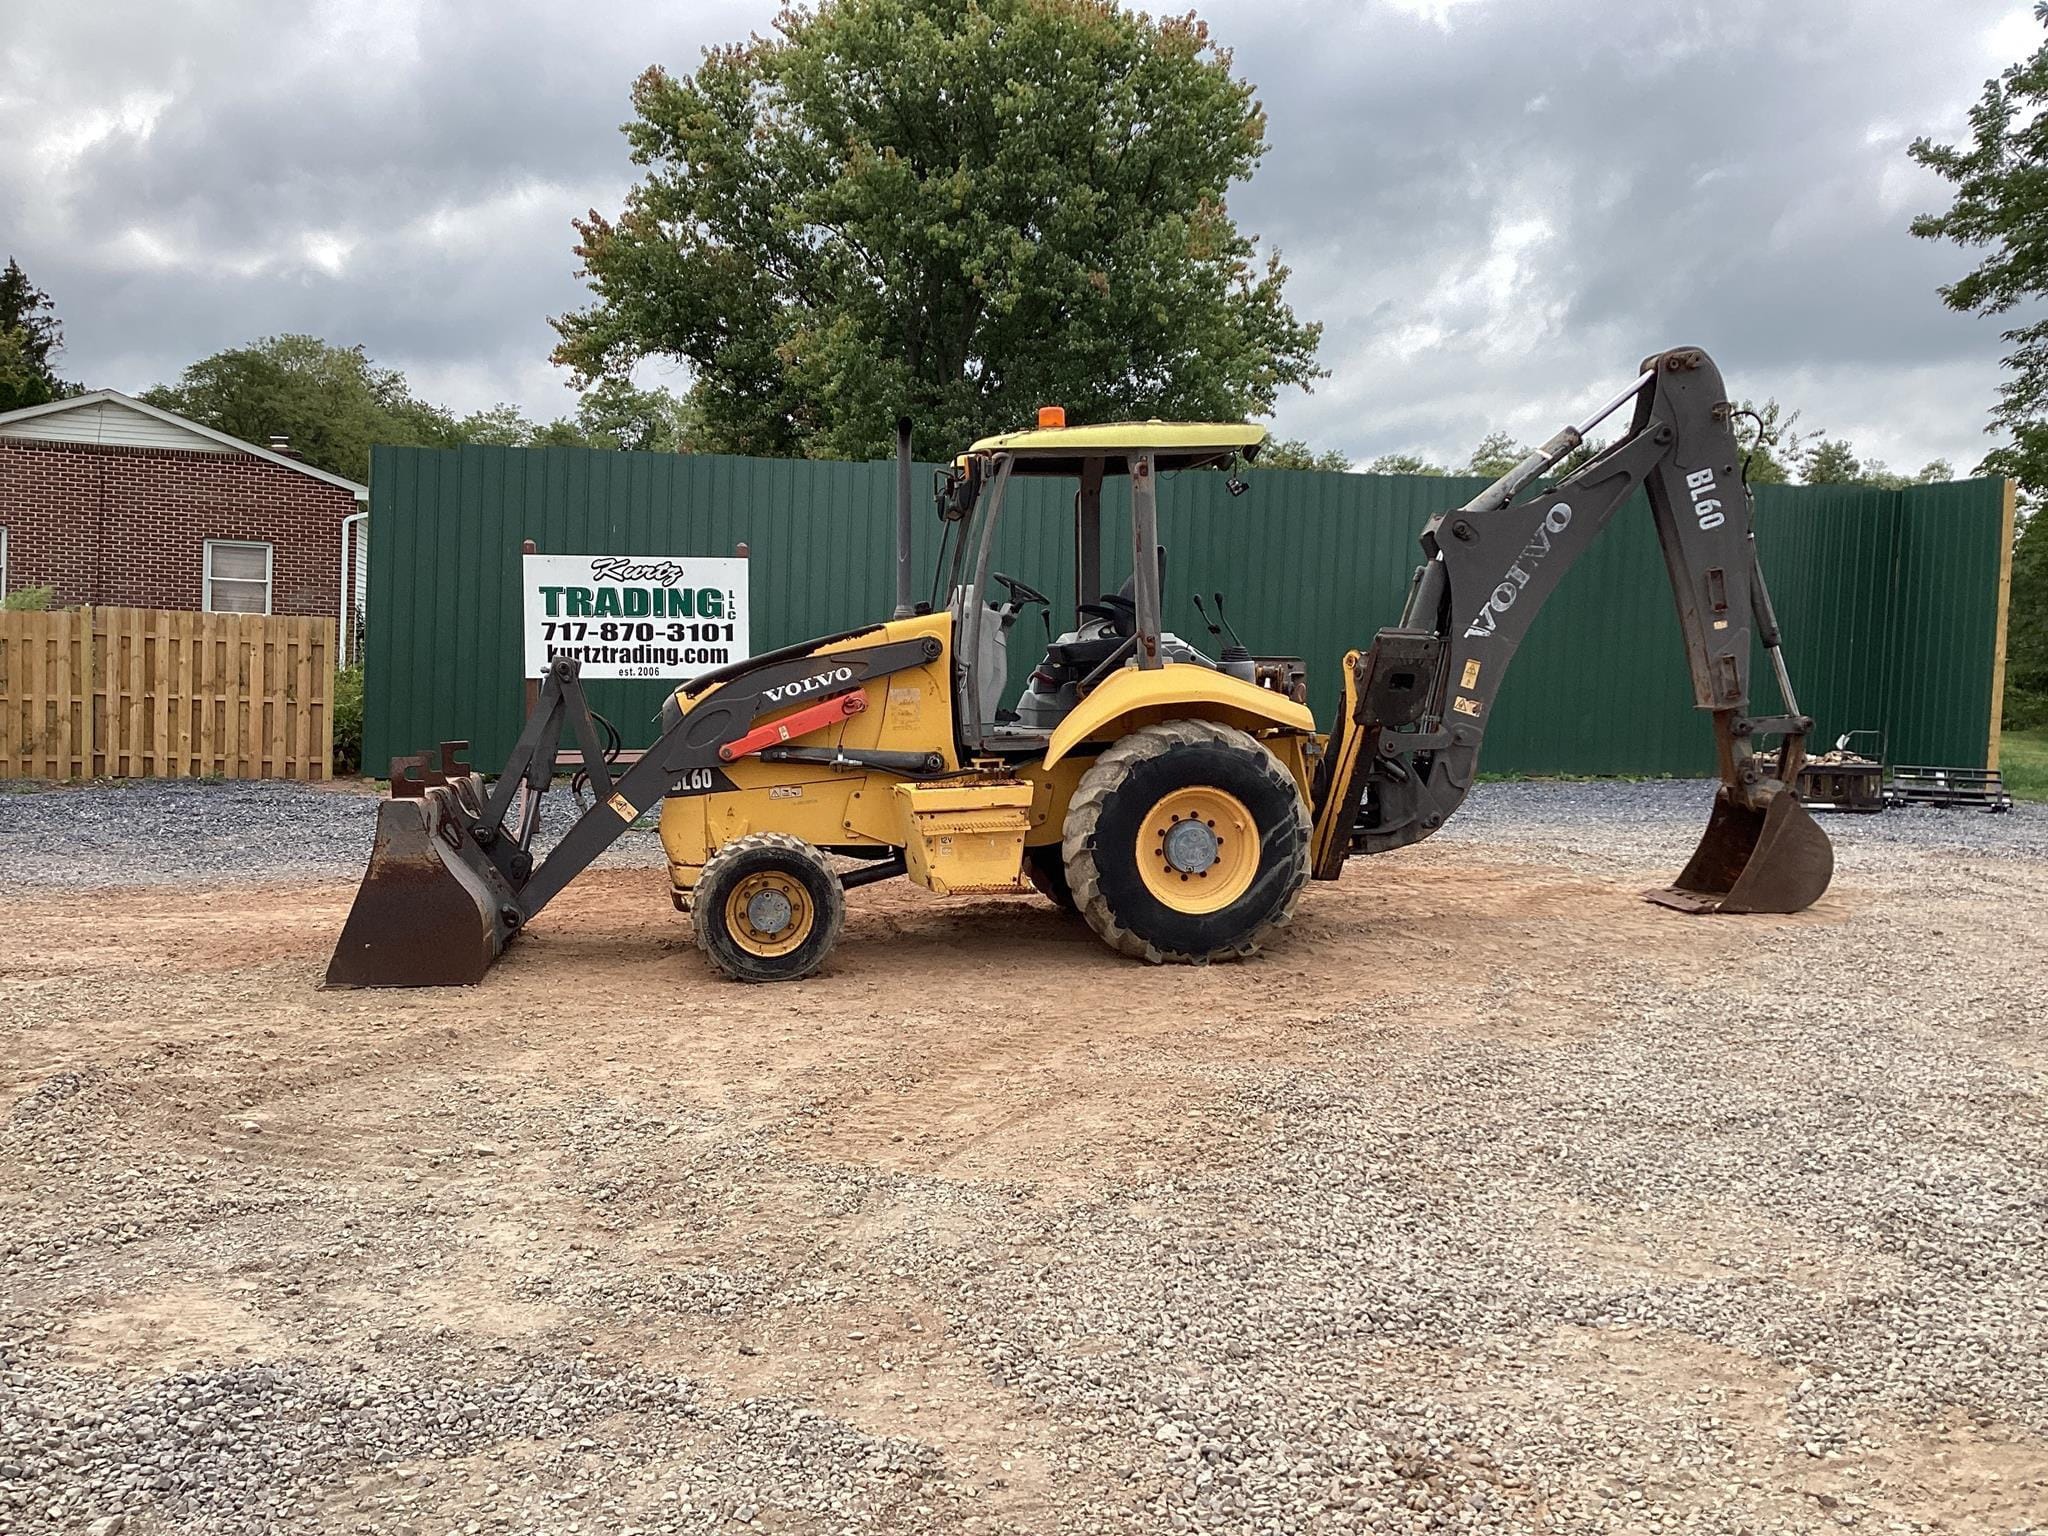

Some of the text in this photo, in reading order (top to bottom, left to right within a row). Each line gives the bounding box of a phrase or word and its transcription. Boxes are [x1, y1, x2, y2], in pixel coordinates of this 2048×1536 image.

[1686, 468, 1725, 530] BL60
[591, 558, 683, 587] Kurtz
[539, 587, 724, 619] TRADING
[541, 623, 734, 642] 717-870-3101
[547, 644, 728, 666] kurtztrading.com
[618, 667, 660, 677] est. 2006
[762, 667, 852, 702] VOLVO
